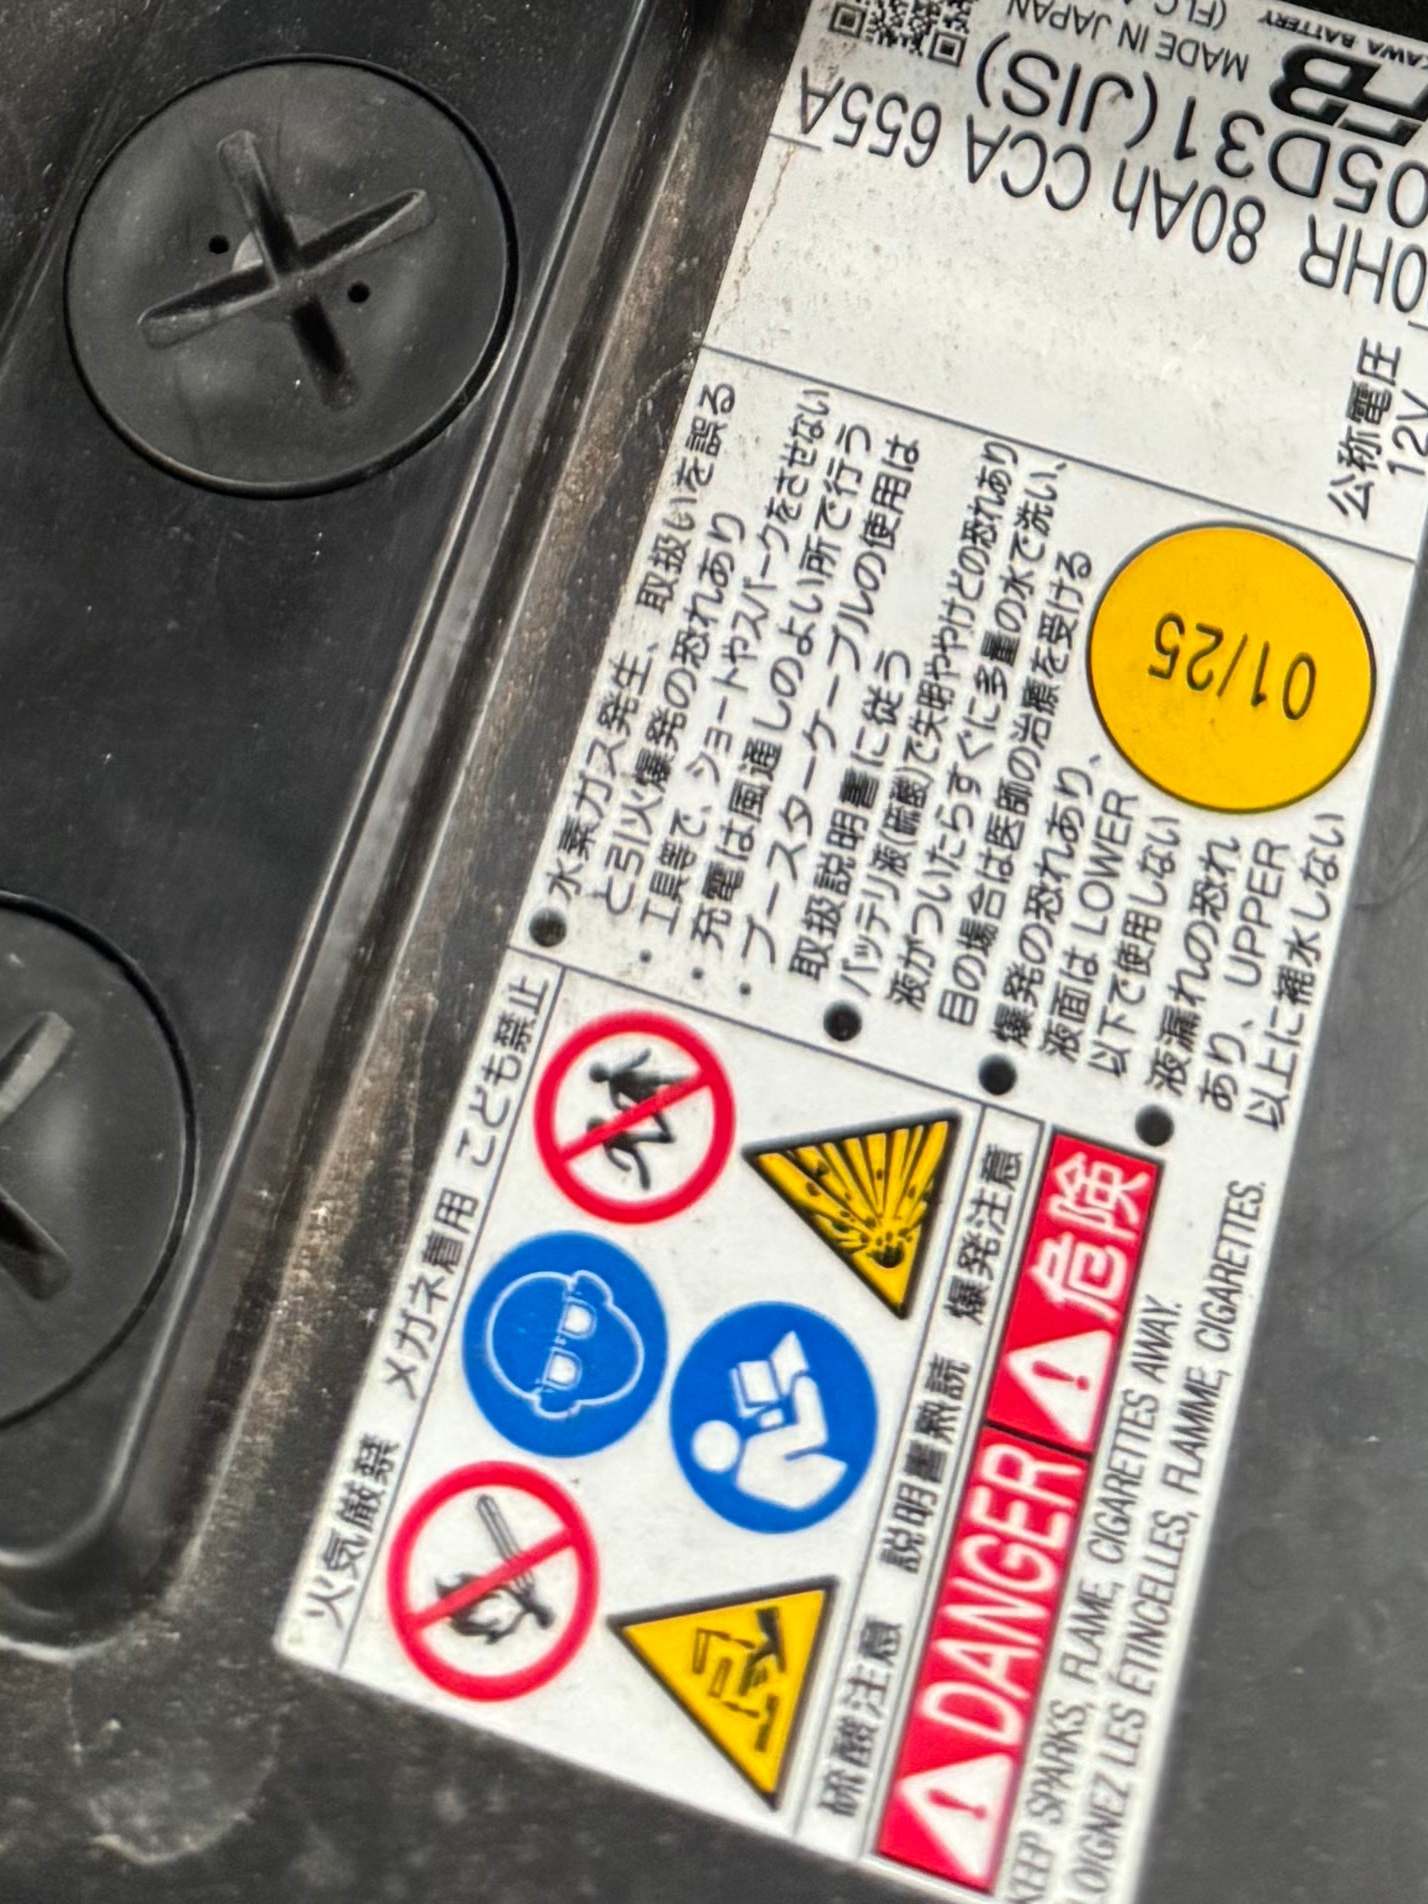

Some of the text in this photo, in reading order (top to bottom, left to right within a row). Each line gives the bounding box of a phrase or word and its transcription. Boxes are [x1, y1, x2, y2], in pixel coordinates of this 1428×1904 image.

[800, 65, 942, 168] 655A
[1118, 20, 1149, 54] IN
[1156, 31, 1249, 82] MADE
[1257, 8, 1355, 48] BATTERY
[966, 112, 1091, 211] CCA
[1113, 157, 1266, 264] 80Ah
[1328, 336, 1402, 522] 公称電圧
[603, 510, 745, 916] と引火爆発の恐れあり
[691, 422, 873, 952] 充電は風通しのよい所で行う
[739, 433, 921, 964] ブースターケーブルの使用は
[886, 461, 1069, 1013] 液がついたらすぐに多量の水で洗い、
[1147, 611, 1317, 721] 01/25
[787, 649, 912, 983] 取扱説明書に従う
[936, 550, 1094, 1028] 目の場合は医師の治療を受ける
[989, 753, 1102, 1049] 爆発の恐れあり、
[1037, 787, 1140, 1061] 液面は LOWER
[1089, 812, 1182, 1078] 以下で使用しない
[1143, 834, 1242, 1098] 液漏れの恐れ
[1197, 836, 1290, 1113] あり、 UPPER
[1247, 811, 1348, 1132] 以上に補水しない
[455, 974, 551, 1169] こども禁止
[384, 1186, 480, 1401] メガネ着用
[943, 1142, 1024, 1328] 爆発注意
[1029, 1149, 1153, 1324] 危険
[1129, 1294, 1185, 1385] AWAY.
[305, 1432, 402, 1630] 火気厳禁
[880, 1352, 973, 1575] 説明書熟読
[1068, 1178, 1269, 1904] OIGNEZ LES ÉTINCELLES, FLAMME, CIGARETTES.
[1088, 1388, 1158, 1565] CIGARETTES
[919, 1441, 1086, 1747] DANGER
[1059, 1578, 1126, 1686] FLAME,
[817, 1618, 903, 1819] 硫酸注意
[1026, 1697, 1094, 1826] SPARKS,
